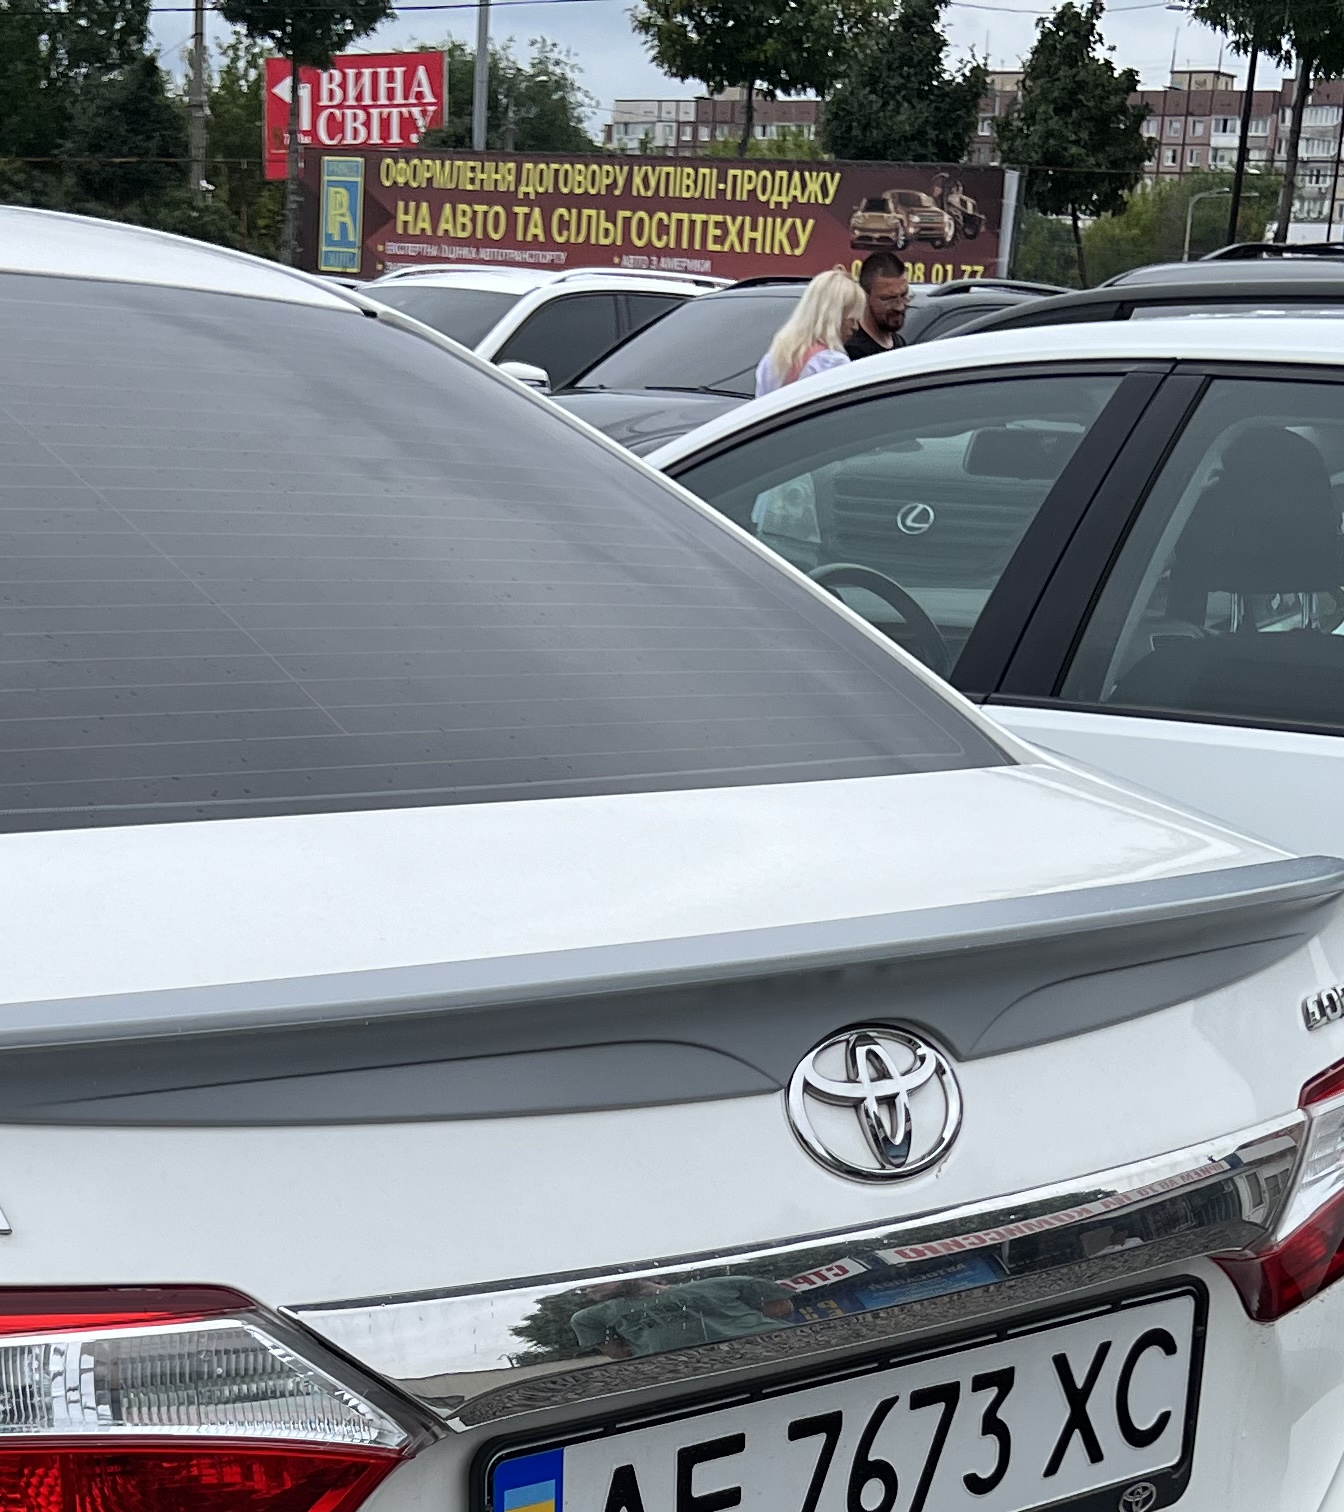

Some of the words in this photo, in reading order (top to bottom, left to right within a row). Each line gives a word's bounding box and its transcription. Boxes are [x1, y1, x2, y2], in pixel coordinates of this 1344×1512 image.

[316, 64, 438, 106] ВИНА
[316, 106, 438, 146] СВІТУ
[379, 157, 517, 193] ОФОРМЛЕННЯ
[517, 162, 629, 200] ДОГОВОРУ
[632, 164, 842, 211] КУПІВЛІ-ПРОДАЖУ
[396, 199, 433, 236] НА
[436, 202, 508, 241] АВТО
[512, 205, 546, 243] ТА
[550, 207, 817, 257] СІЛЬГОСПТЕХНІКУ
[931, 263, 954, 284] 01
[960, 264, 985, 280] 77
[1042, 1327, 1178, 1479] XC
